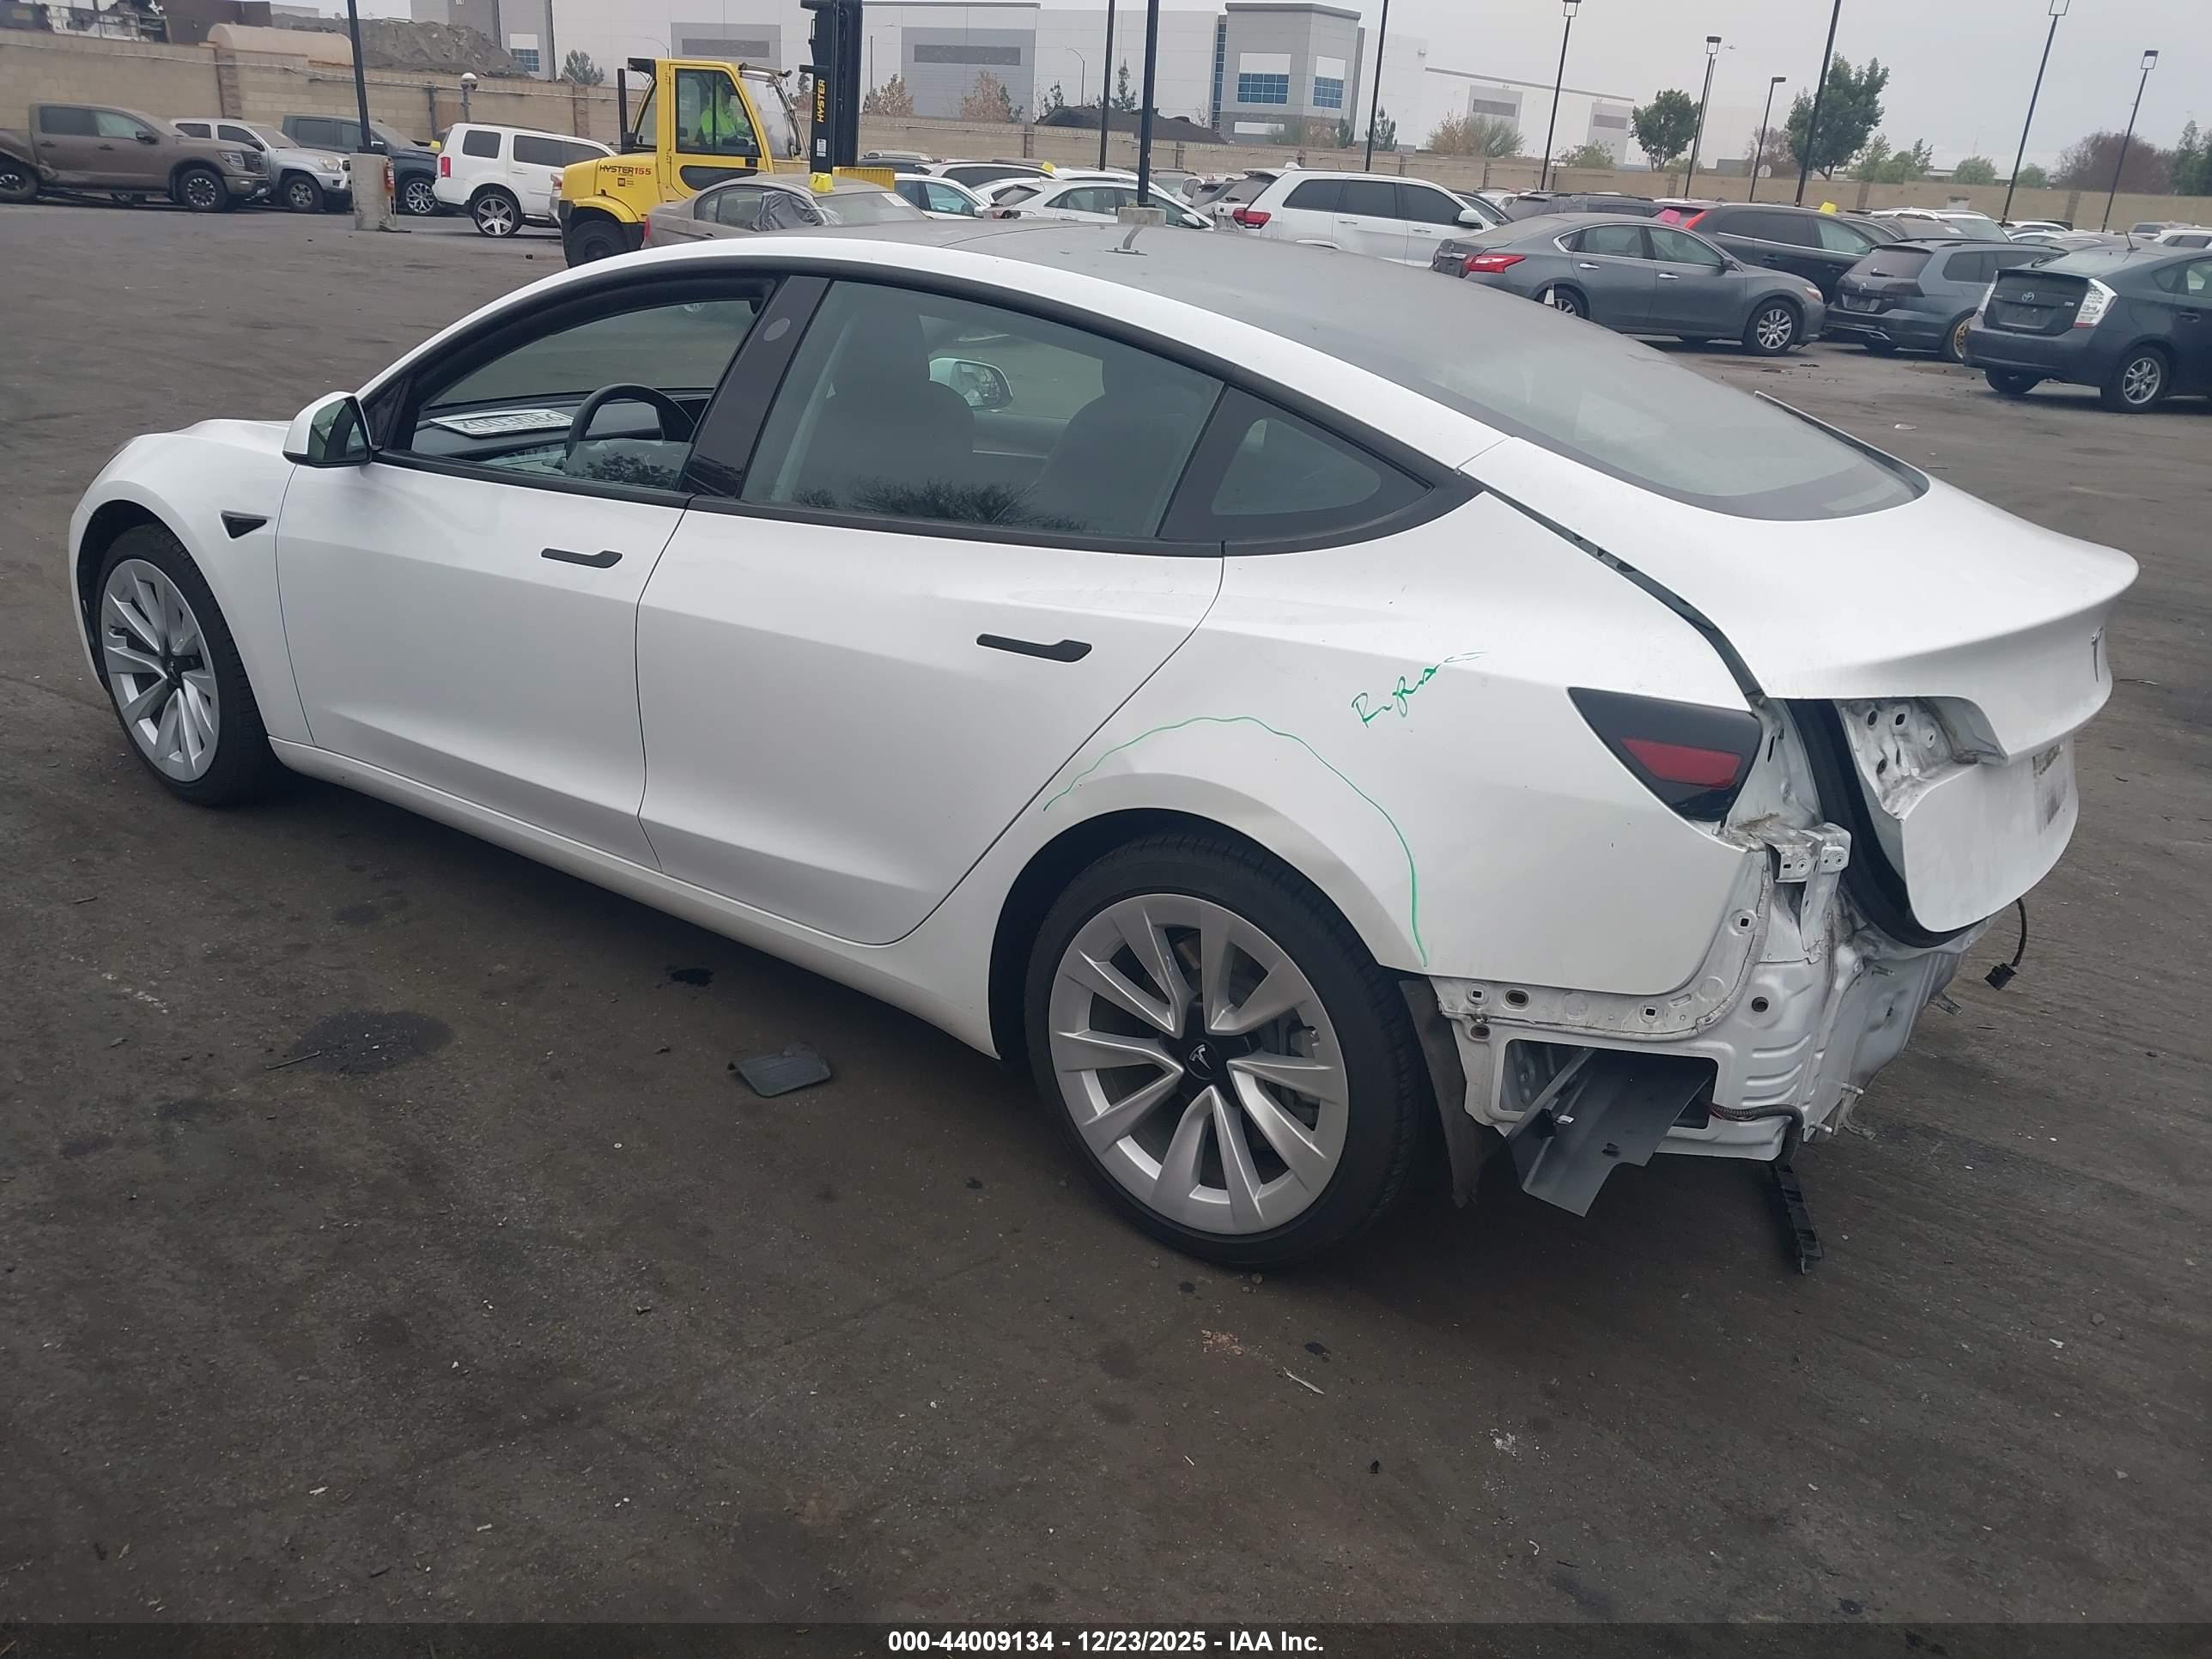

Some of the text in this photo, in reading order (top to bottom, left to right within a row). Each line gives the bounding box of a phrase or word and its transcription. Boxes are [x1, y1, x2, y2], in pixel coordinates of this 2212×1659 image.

[817, 78, 826, 123] HYSTER
[599, 164, 652, 176] HYSTER 155
